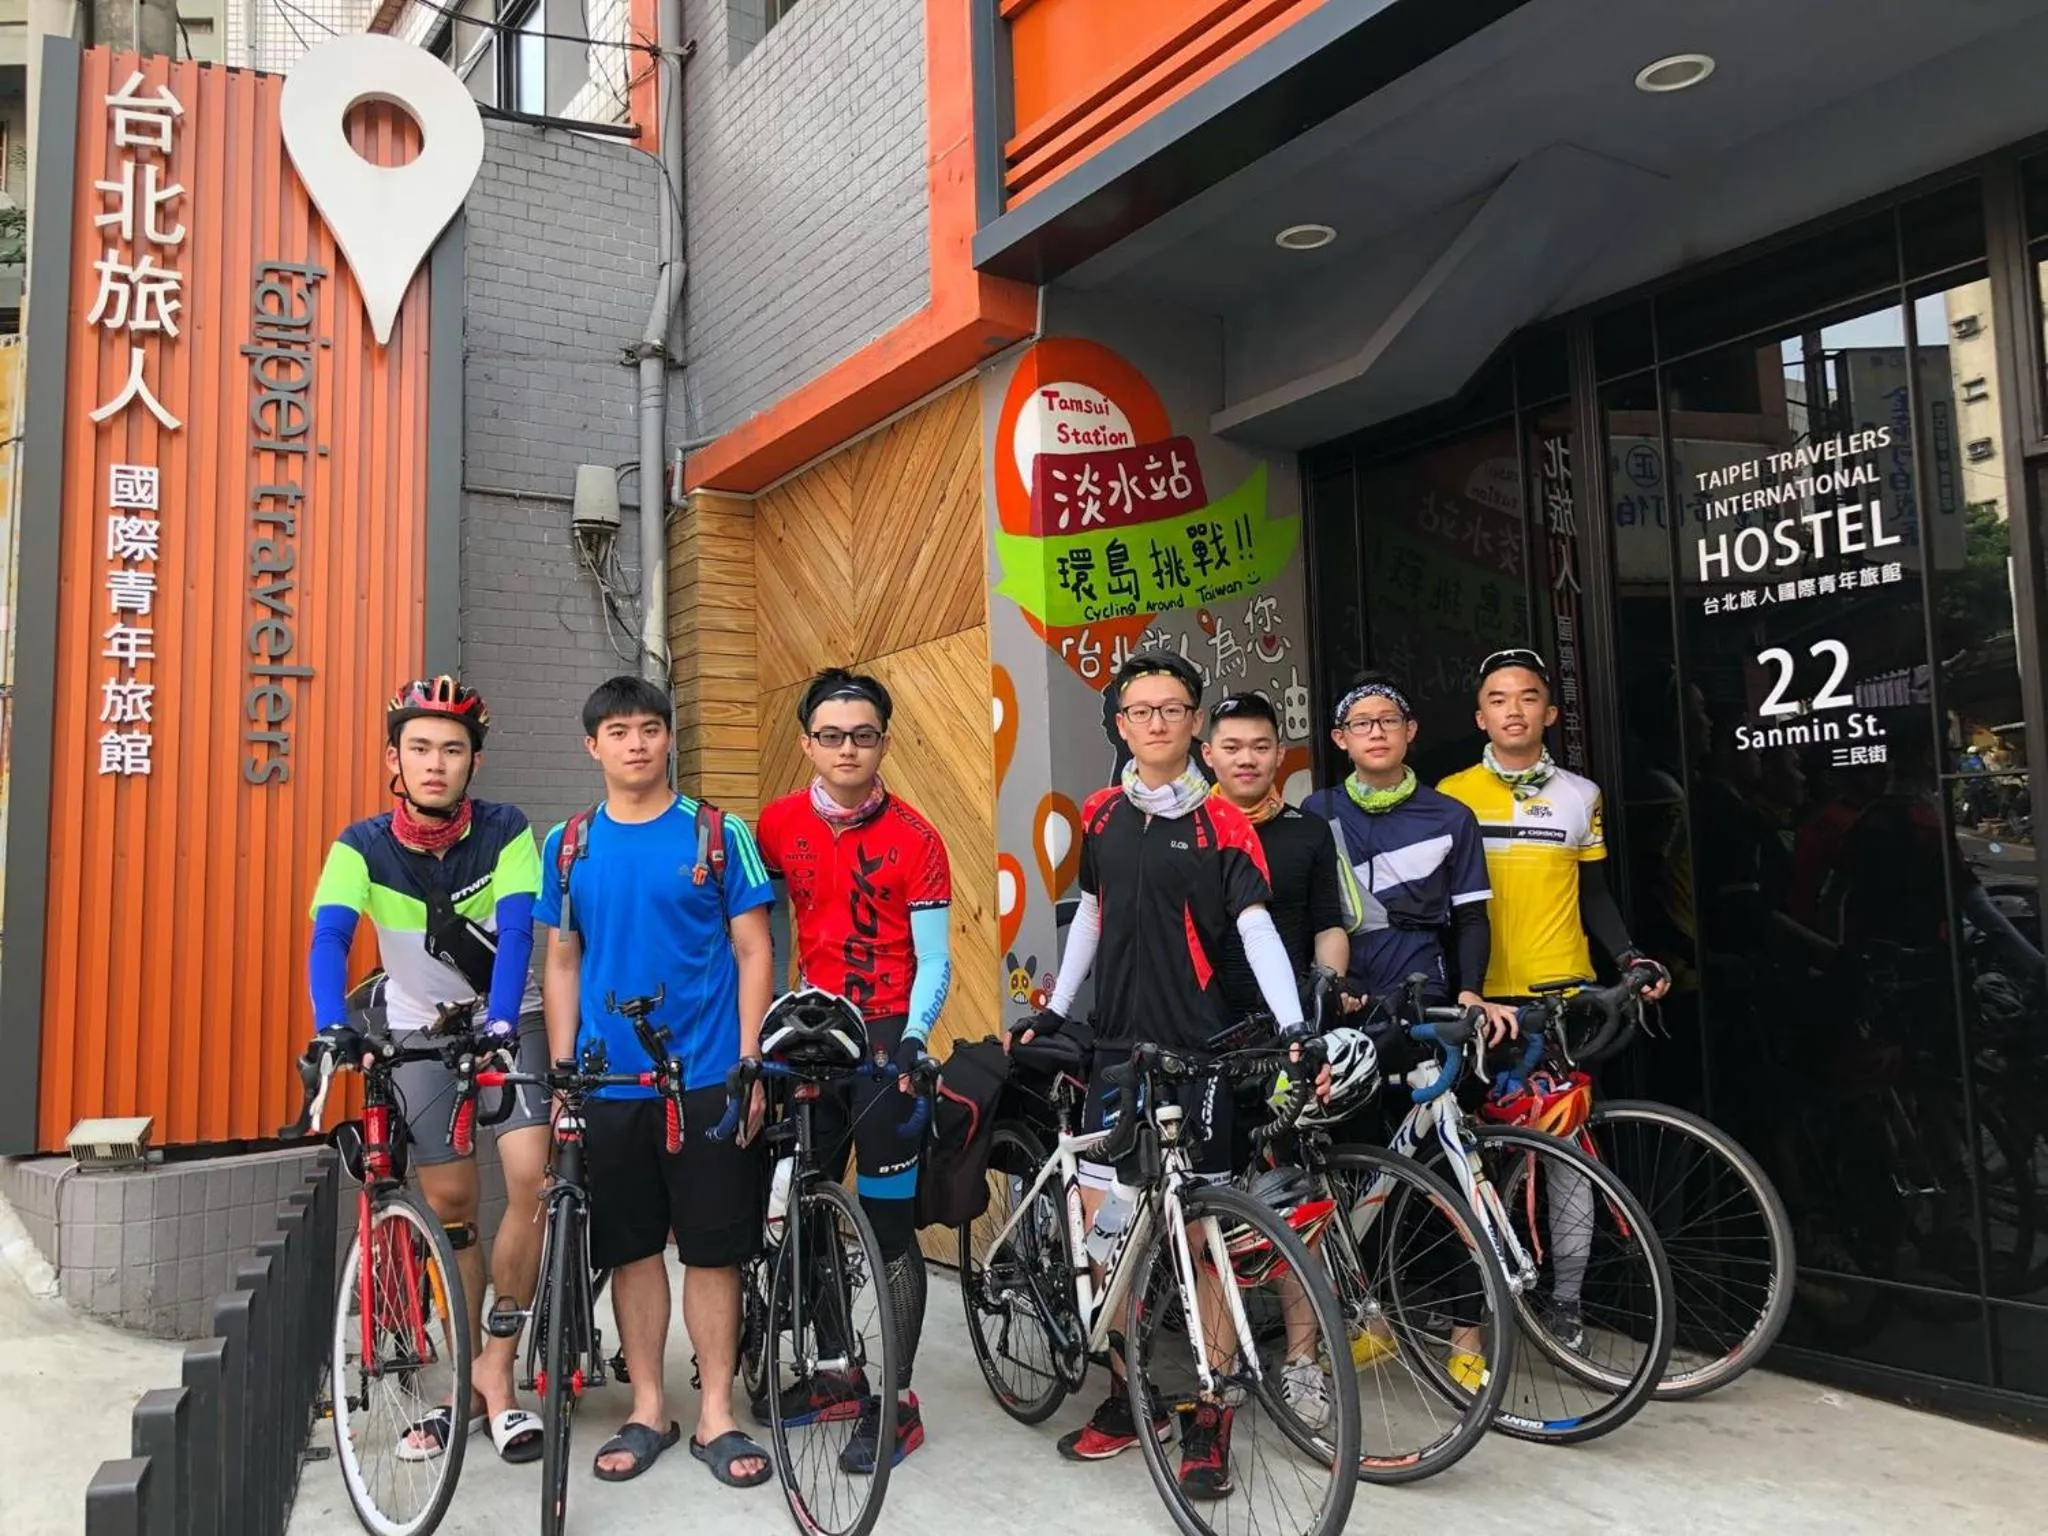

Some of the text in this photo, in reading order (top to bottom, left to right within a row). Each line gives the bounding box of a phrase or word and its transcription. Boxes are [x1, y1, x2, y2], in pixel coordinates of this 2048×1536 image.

[87, 70, 187, 776] 台北旅人 國際青年旅館
[1040, 389, 1109, 415] Tamsui
[1056, 422, 1129, 446] Station
[1696, 426, 1892, 492] TAIPEI TRAVELERS
[1052, 450, 1193, 528] 淡水站
[1705, 463, 1880, 521] INTERNATIONAL
[241, 259, 327, 784] taipei travelers
[1698, 500, 1901, 582] HOSTEL
[1084, 601, 1136, 621] Cycling
[1195, 579, 1242, 603] Taiwan
[1703, 562, 1902, 615] 台北旅人國際青年旅館
[1757, 638, 1853, 717] 22
[1735, 713, 1887, 750] Sanmin St.
[1832, 744, 1887, 767] 三民街
